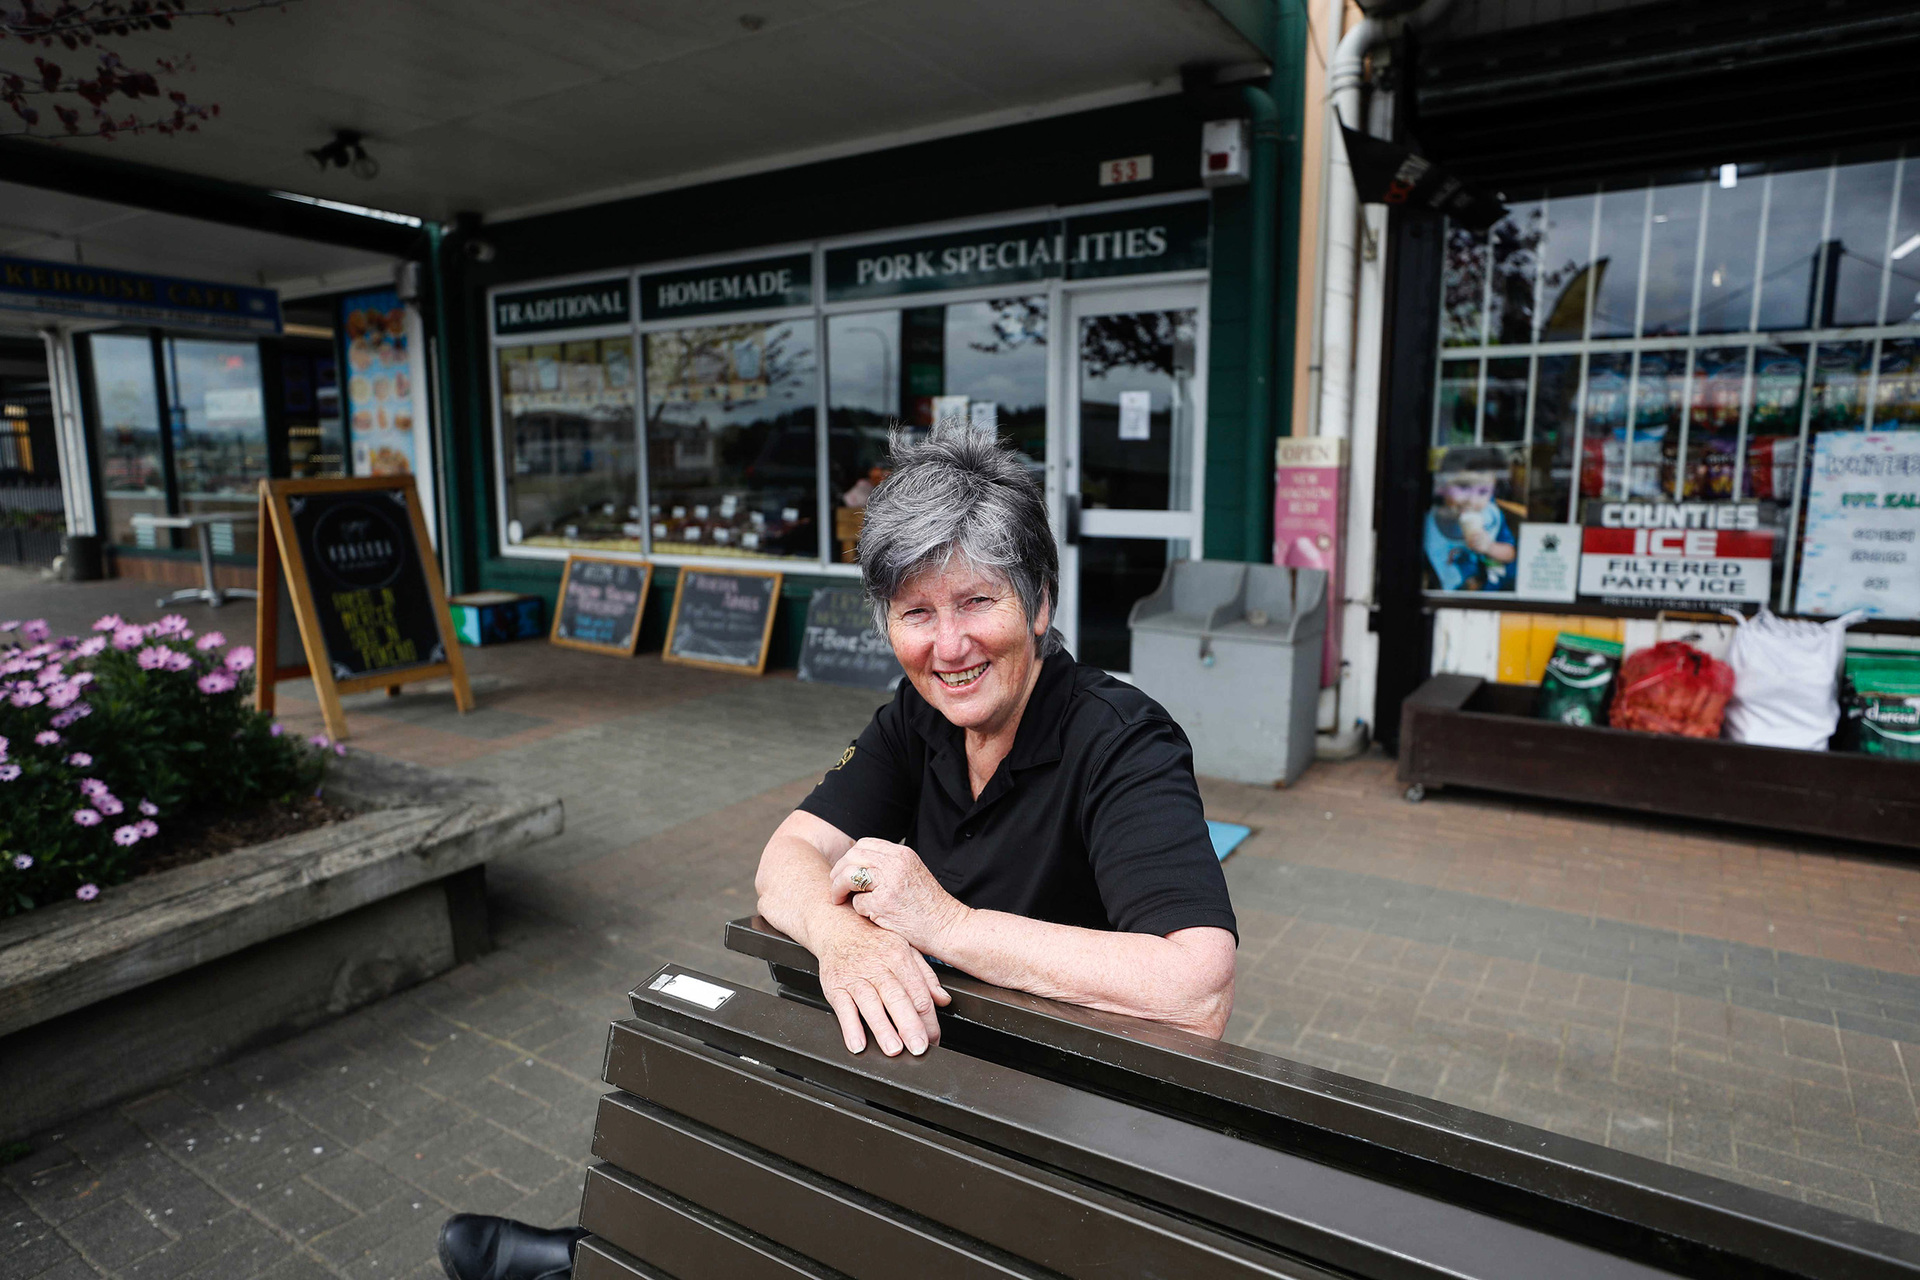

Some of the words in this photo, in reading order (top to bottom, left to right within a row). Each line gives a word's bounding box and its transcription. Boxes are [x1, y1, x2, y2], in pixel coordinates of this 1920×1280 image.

[1110, 160, 1139, 184] 53
[856, 250, 937, 285] PORK
[940, 226, 1168, 276] SPECIALITIES
[167, 282, 240, 311] CAFE
[658, 268, 793, 308] HOMEMADE
[499, 290, 626, 326] TRADITIONAL
[1601, 502, 1761, 530] COUNTIES
[1633, 530, 1719, 557] ICE
[1607, 558, 1742, 578] FILTERED
[1601, 574, 1695, 594] PARTY
[1697, 578, 1748, 596] ICE
